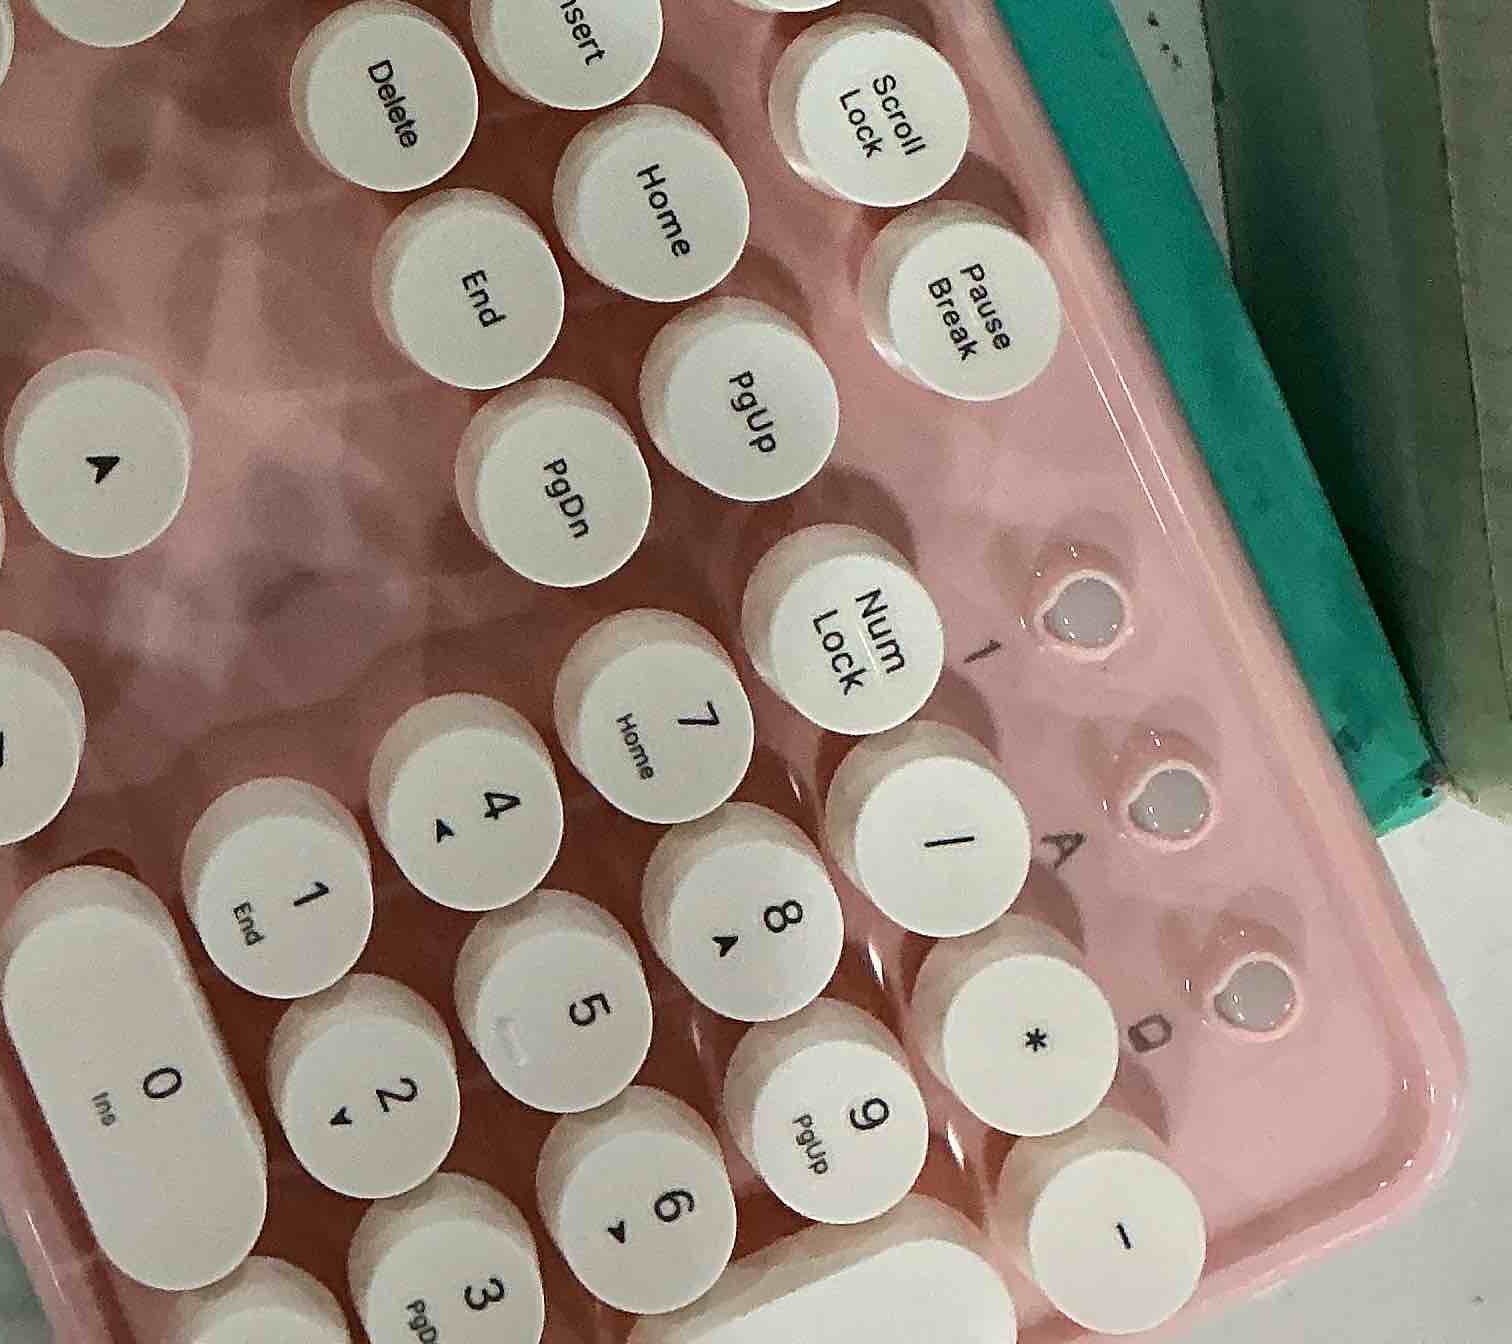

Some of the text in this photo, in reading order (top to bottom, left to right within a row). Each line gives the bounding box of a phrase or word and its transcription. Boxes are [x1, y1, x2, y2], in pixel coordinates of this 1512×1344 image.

[368, 60, 417, 148] Delete
[840, 89, 883, 158] Lock
[873, 75, 925, 155] Scroll
[637, 164, 690, 256] Home
[462, 270, 506, 327] End
[928, 277, 978, 360] Break
[960, 264, 1010, 350] Pause
[729, 371, 776, 452] PgUp
[544, 458, 589, 538] PgDn
[813, 609, 867, 695] Lock
[856, 588, 904, 674] Num
[677, 701, 720, 726] 7
[616, 713, 654, 780] Home
[484, 792, 520, 820] 4
[1041, 832, 1086, 869] A
[294, 882, 329, 906] 1
[764, 900, 803, 933] 8
[233, 902, 264, 946] End
[569, 993, 610, 1026] 5
[143, 1067, 182, 1100] 0
[376, 1078, 417, 1112] 2
[92, 1092, 116, 1126] Ins
[850, 1098, 889, 1130] 9
[793, 1114, 828, 1174] PgUp
[654, 1190, 695, 1223] 6
[464, 1278, 504, 1311] 3
